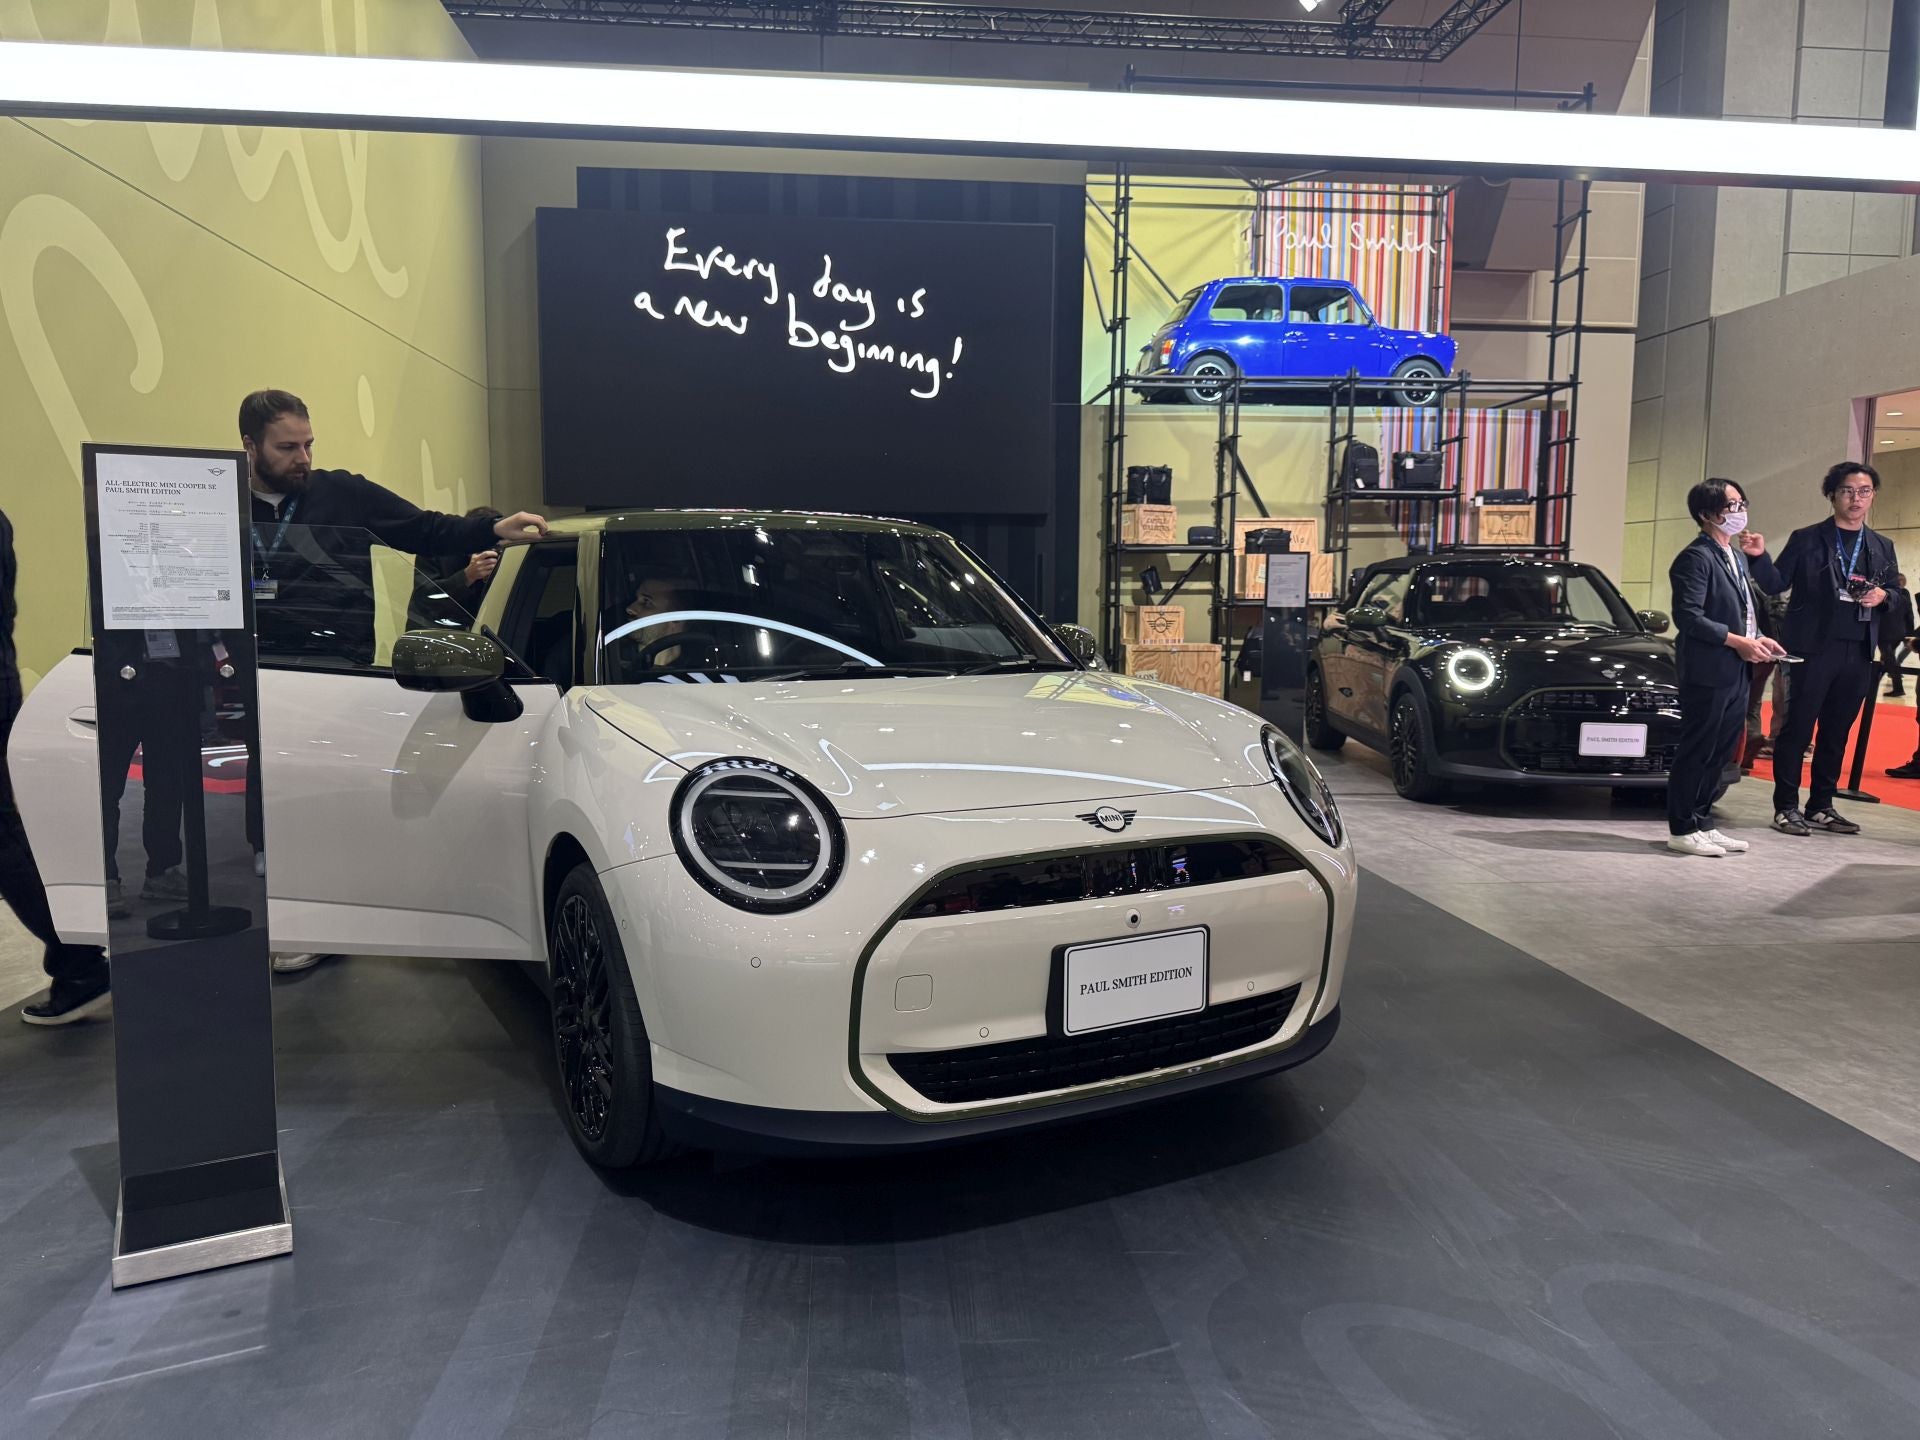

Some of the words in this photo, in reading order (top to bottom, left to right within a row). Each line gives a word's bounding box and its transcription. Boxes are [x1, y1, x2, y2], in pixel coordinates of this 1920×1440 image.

[1273, 215, 1333, 250] Paul
[1349, 222, 1438, 254] Smith
[663, 227, 779, 305] Every
[812, 254, 876, 331] day
[897, 287, 927, 318] is
[633, 291, 665, 320] a
[674, 296, 748, 335] new
[787, 292, 963, 399] beginning!
[105, 479, 158, 488] ALL-ELECTRIC
[178, 482, 207, 490] COOPER
[1099, 814, 1123, 823] MINI
[1080, 980, 1110, 996] PAUL
[1112, 973, 1148, 990] SMITH
[1149, 966, 1193, 984] EDITION
